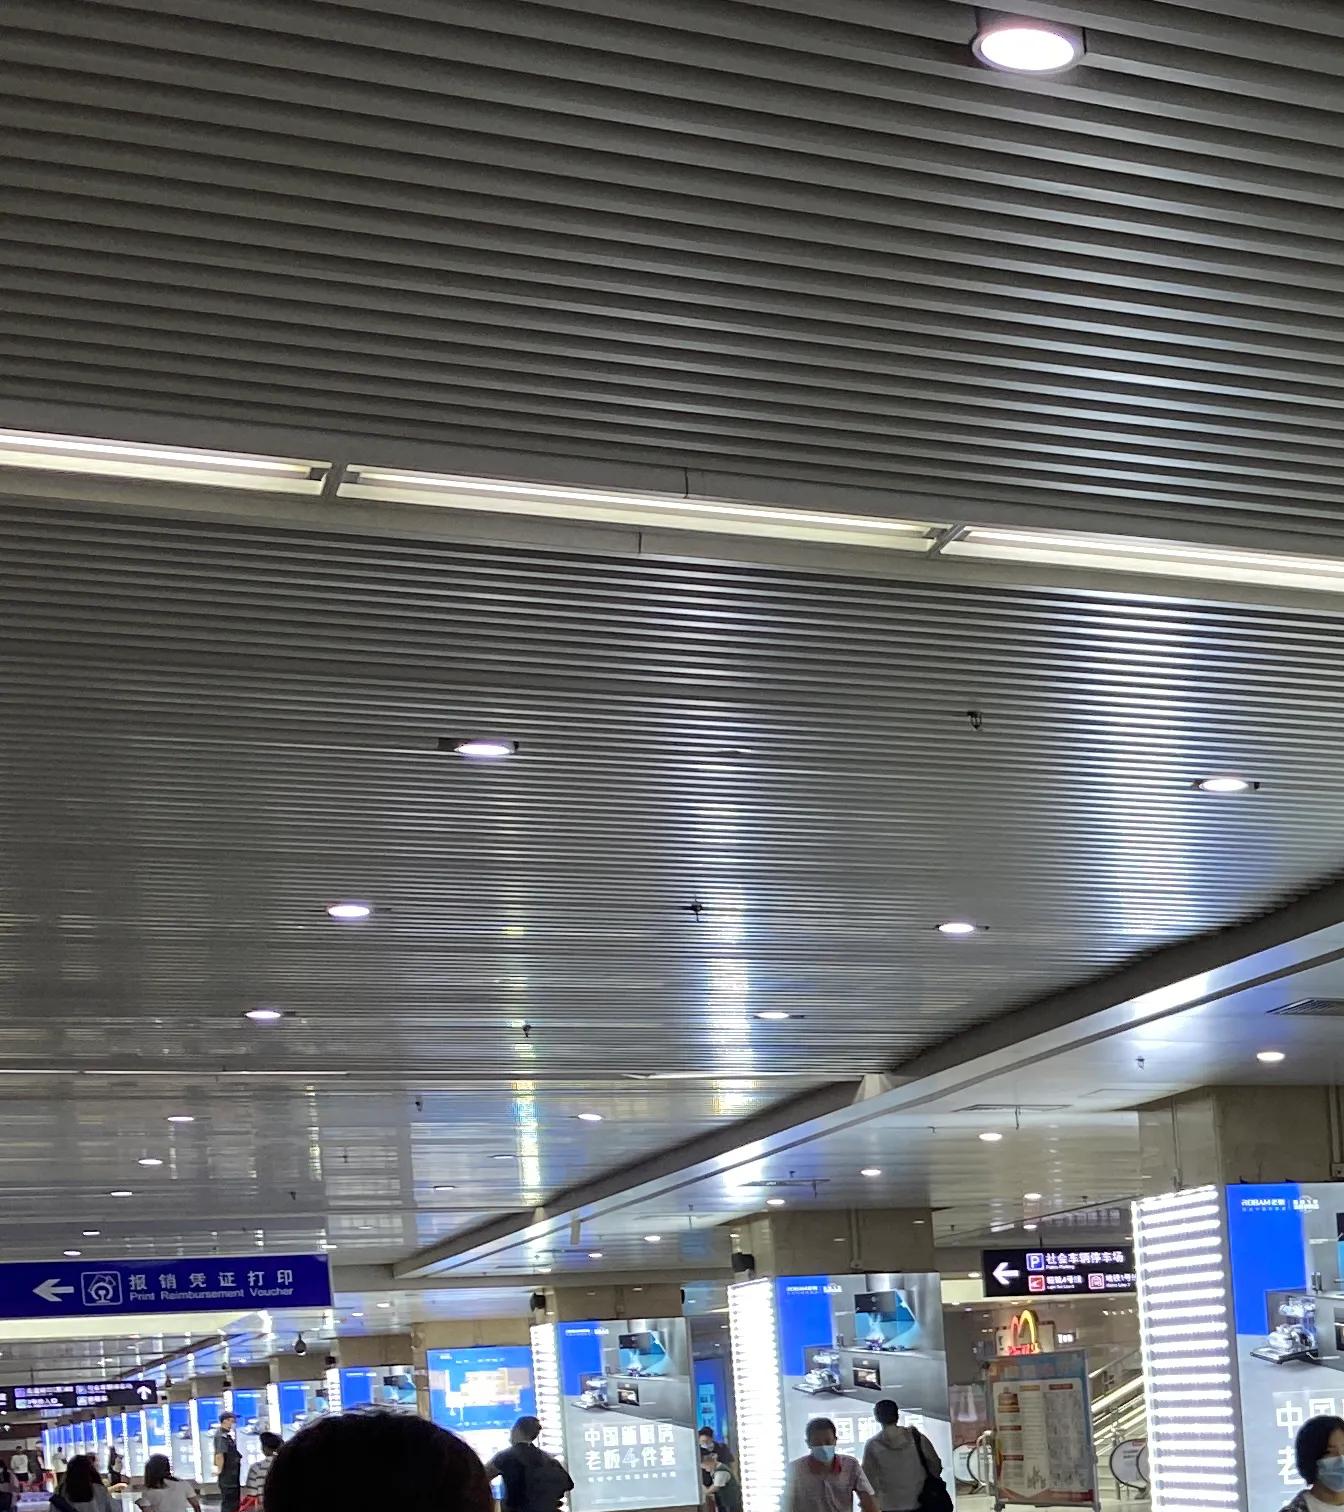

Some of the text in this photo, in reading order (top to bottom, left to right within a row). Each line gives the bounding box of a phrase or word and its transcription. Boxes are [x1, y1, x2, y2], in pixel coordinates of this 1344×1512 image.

[1045, 1251, 1124, 1265] 社会车辆停车场
[128, 1268, 294, 1291] 报销凭证打印
[129, 1286, 294, 1302] Print Reimbursement Voucher
[584, 1446, 677, 1472] 老板4件套
